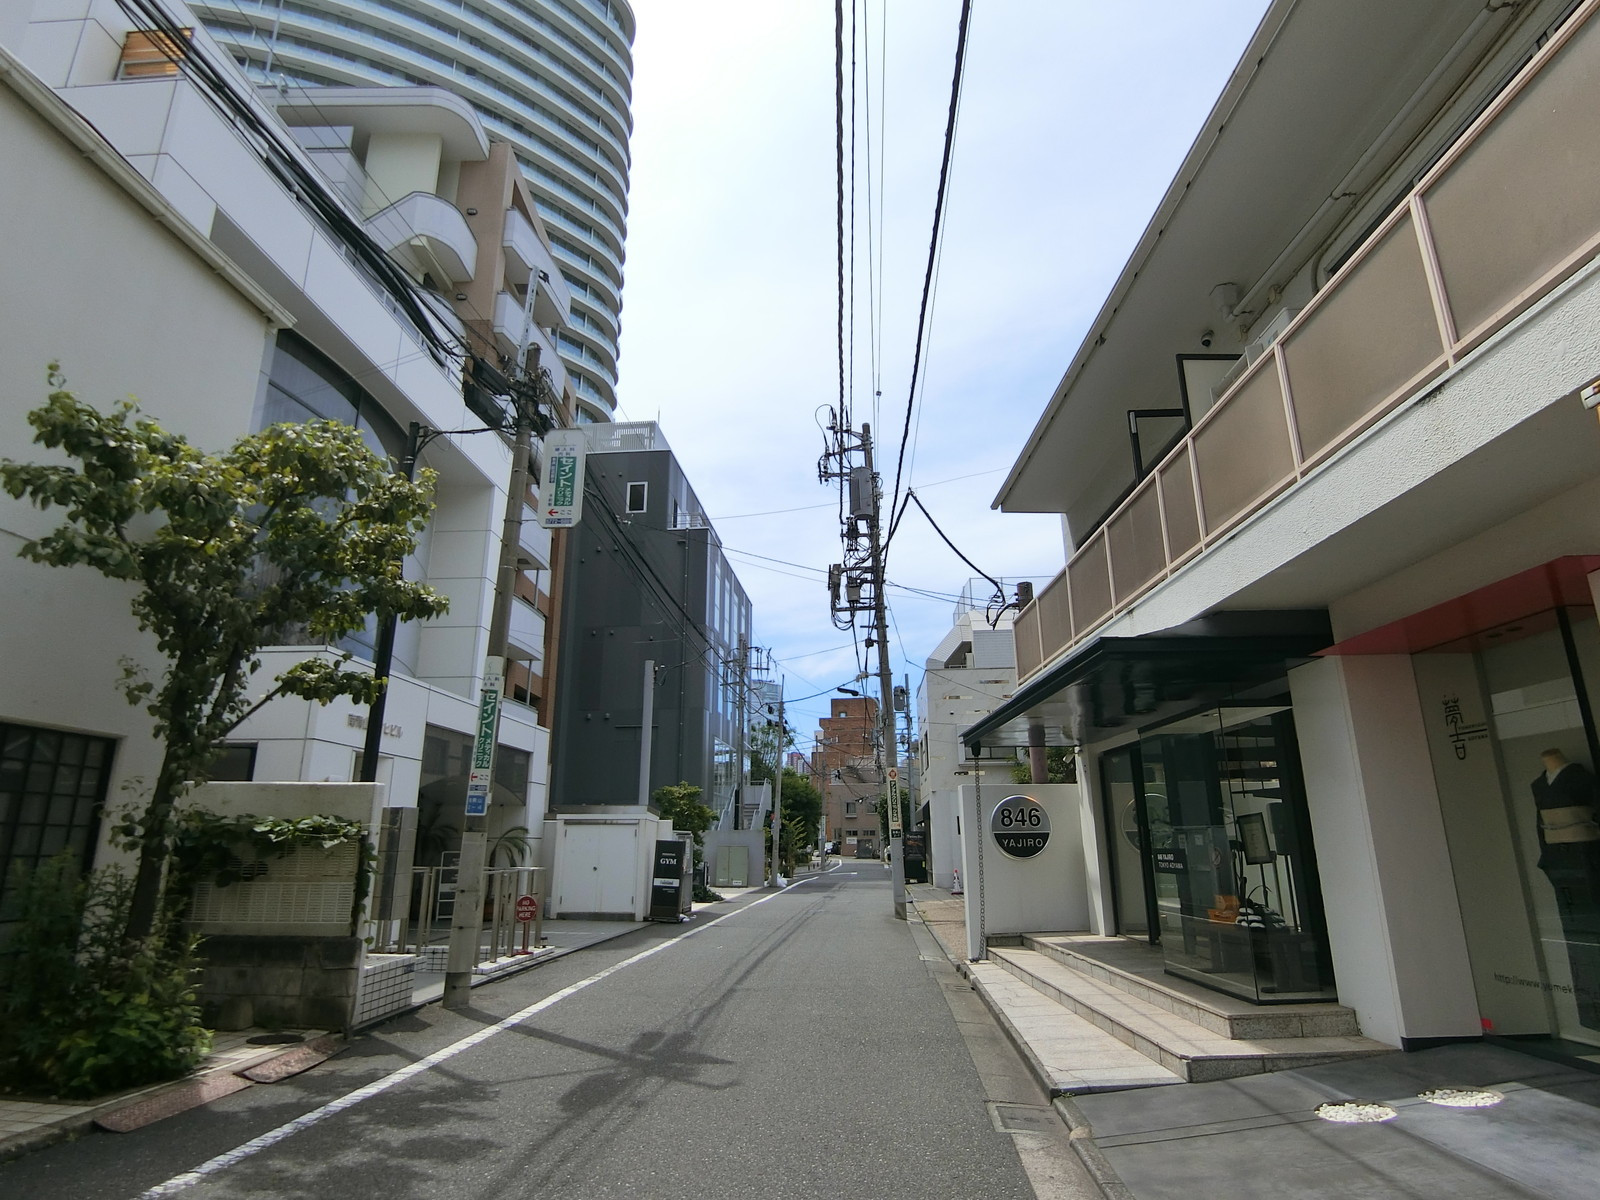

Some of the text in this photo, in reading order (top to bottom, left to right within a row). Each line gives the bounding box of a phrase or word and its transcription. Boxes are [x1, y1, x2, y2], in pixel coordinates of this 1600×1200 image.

[560, 457, 574, 487] セイント
[481, 693, 496, 738] セイント
[475, 737, 484, 768] クリニック
[481, 737, 492, 768] メディカル
[1001, 807, 1041, 827] 846
[1002, 838, 1043, 847] YAJIRO
